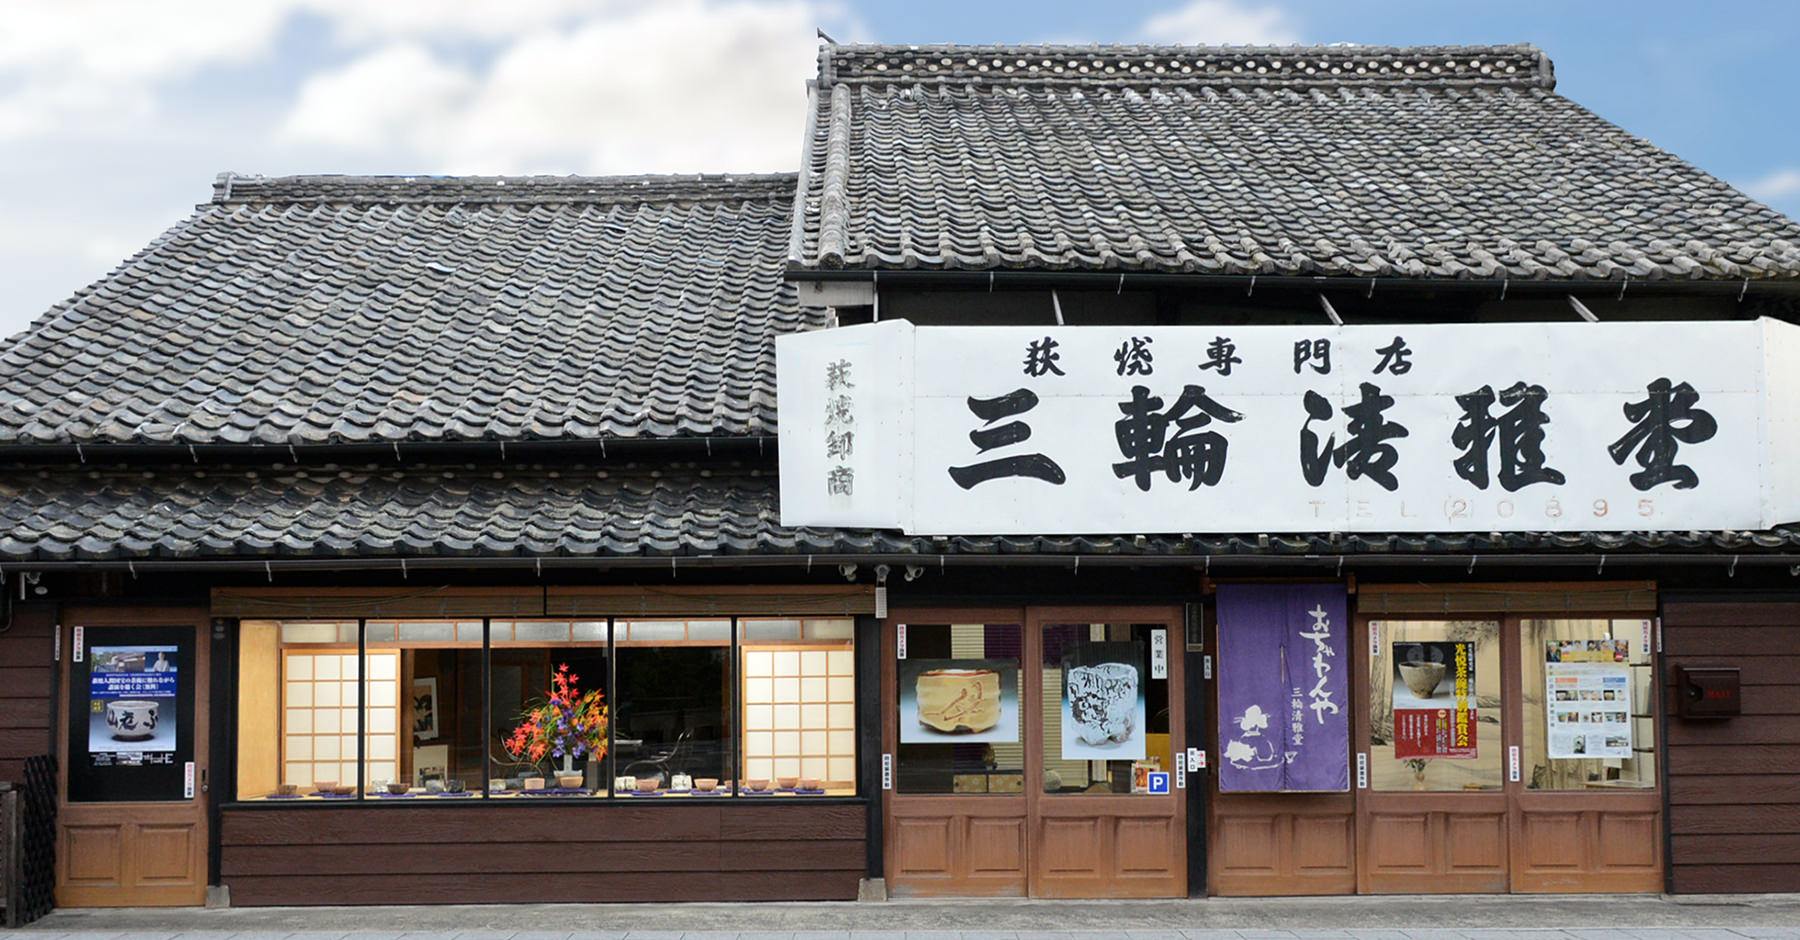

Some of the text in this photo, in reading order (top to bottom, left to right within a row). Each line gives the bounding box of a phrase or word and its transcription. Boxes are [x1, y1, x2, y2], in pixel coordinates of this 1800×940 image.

[1023, 336, 1412, 378] 萩焼専門店
[949, 377, 1718, 493] 三輪清雅堂
[1308, 500, 1418, 518] TEL
[1154, 634, 1164, 674] 営業中
[1299, 604, 1339, 725] おちゃわんや
[1291, 687, 1305, 746] 三輪清雅堂
[1153, 776, 1164, 790] P
